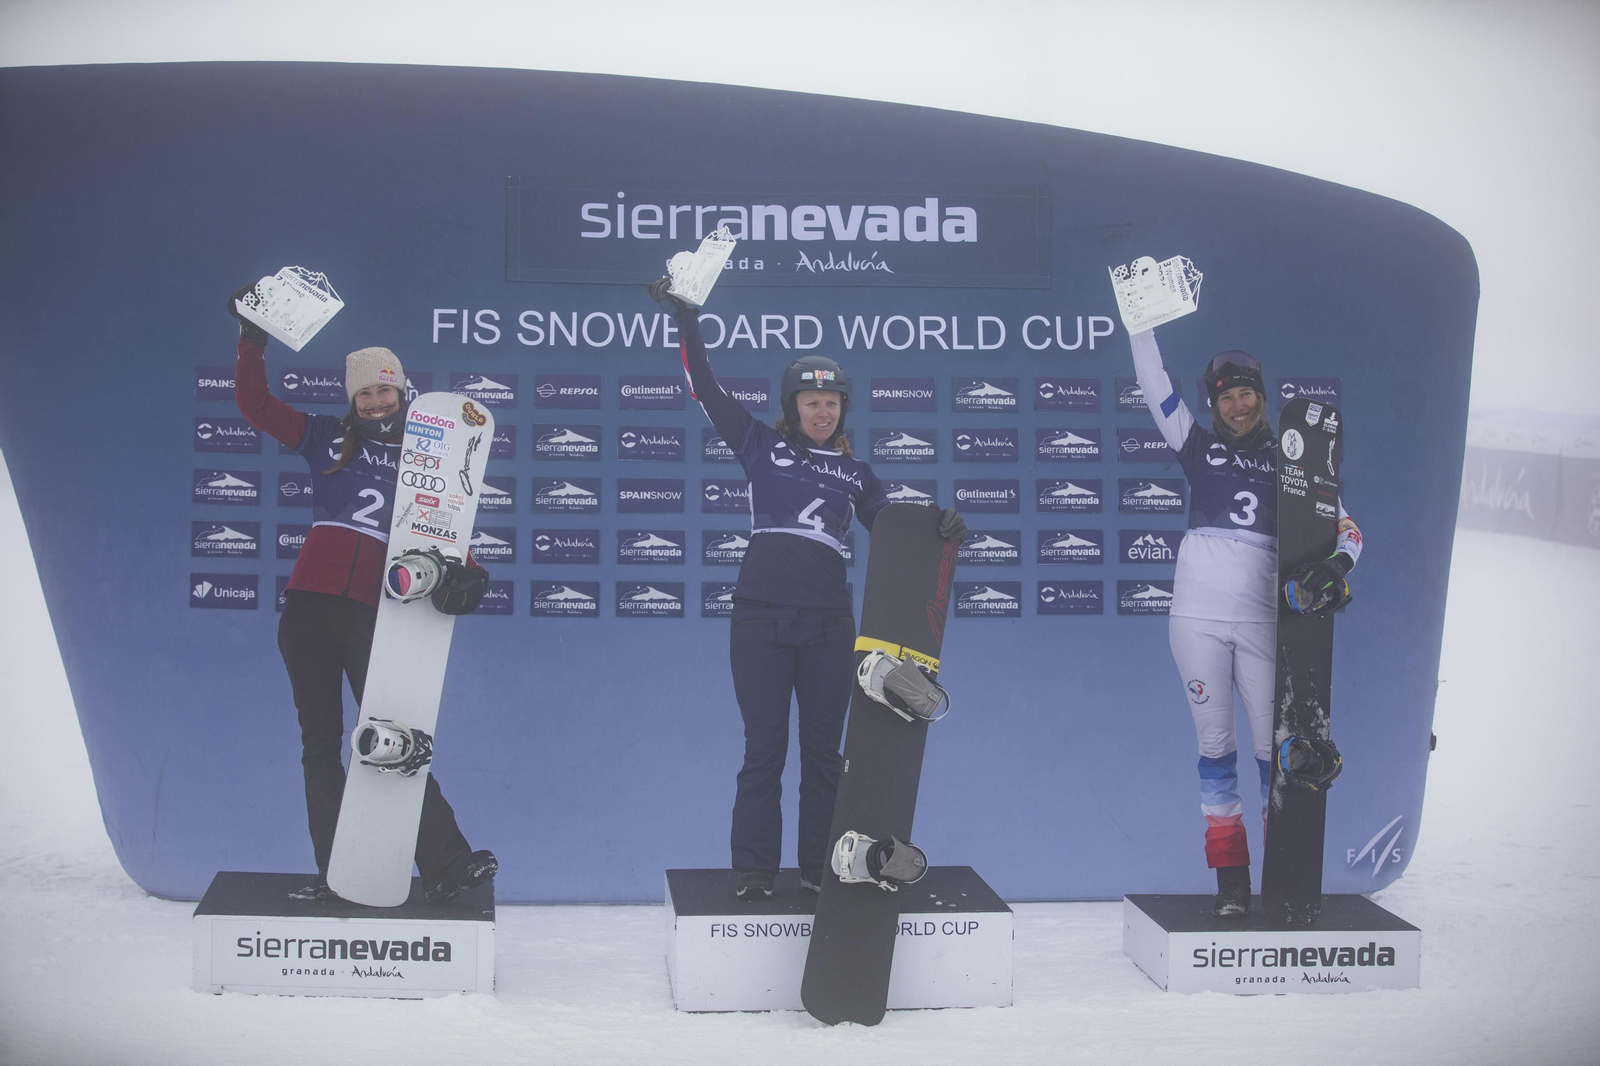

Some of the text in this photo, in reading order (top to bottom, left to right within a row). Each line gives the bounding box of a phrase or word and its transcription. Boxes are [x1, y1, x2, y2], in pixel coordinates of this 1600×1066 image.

[580, 192, 978, 243] sierranevada
[432, 308, 501, 345] FIS
[838, 315, 1006, 351] WORLD
[1023, 316, 1115, 352] CUP
[199, 379, 236, 388] SPAINS
[621, 385, 674, 397] Continental
[872, 390, 933, 398] SPAINSNOW
[955, 396, 1017, 406] sierranevada
[1119, 396, 1147, 405] sierra
[410, 410, 455, 430] foodora
[407, 424, 442, 437] HINTON
[433, 441, 451, 451] OIG
[536, 445, 598, 453] sierranevada
[1038, 446, 1099, 454] sierranevada
[705, 448, 734, 456] sierra
[872, 447, 935, 457] sierranevada
[1284, 466, 1304, 478] TEAM
[1280, 474, 1308, 488] TOYOTA
[195, 487, 257, 497] sierranevada
[619, 491, 682, 499] SPAINSNOW
[957, 489, 1009, 501] Continental
[1283, 484, 1306, 497] France
[535, 496, 597, 505] sierranevada
[1038, 496, 1099, 505] sierranevada
[1122, 498, 1182, 506] sierranevada
[351, 488, 385, 527] 2
[1229, 490, 1258, 526] 3
[797, 497, 826, 532] 4
[410, 522, 457, 540] MONZAS
[194, 541, 256, 550] sierranevada
[471, 546, 512, 555] anevada
[620, 548, 682, 557] sierranevada
[705, 549, 746, 558] sierrane
[957, 549, 1018, 558] sierranevada
[1040, 546, 1100, 556] sierranevada
[1128, 545, 1172, 560] evian
[214, 587, 255, 601] Unicaja
[534, 600, 596, 610] sierranevada
[619, 601, 681, 610] sierranevada
[957, 601, 1018, 610] sierranevada
[710, 922, 738, 937] FIS
[744, 922, 812, 937] SNOWB
[941, 921, 980, 936] CUP
[236, 931, 452, 962] sierranevada
[1192, 941, 1396, 968] sierranevada
[281, 966, 336, 976] granada
[351, 965, 405, 979] Andalucía
[1235, 974, 1287, 984] granada
[1300, 971, 1352, 984] Andalucía
